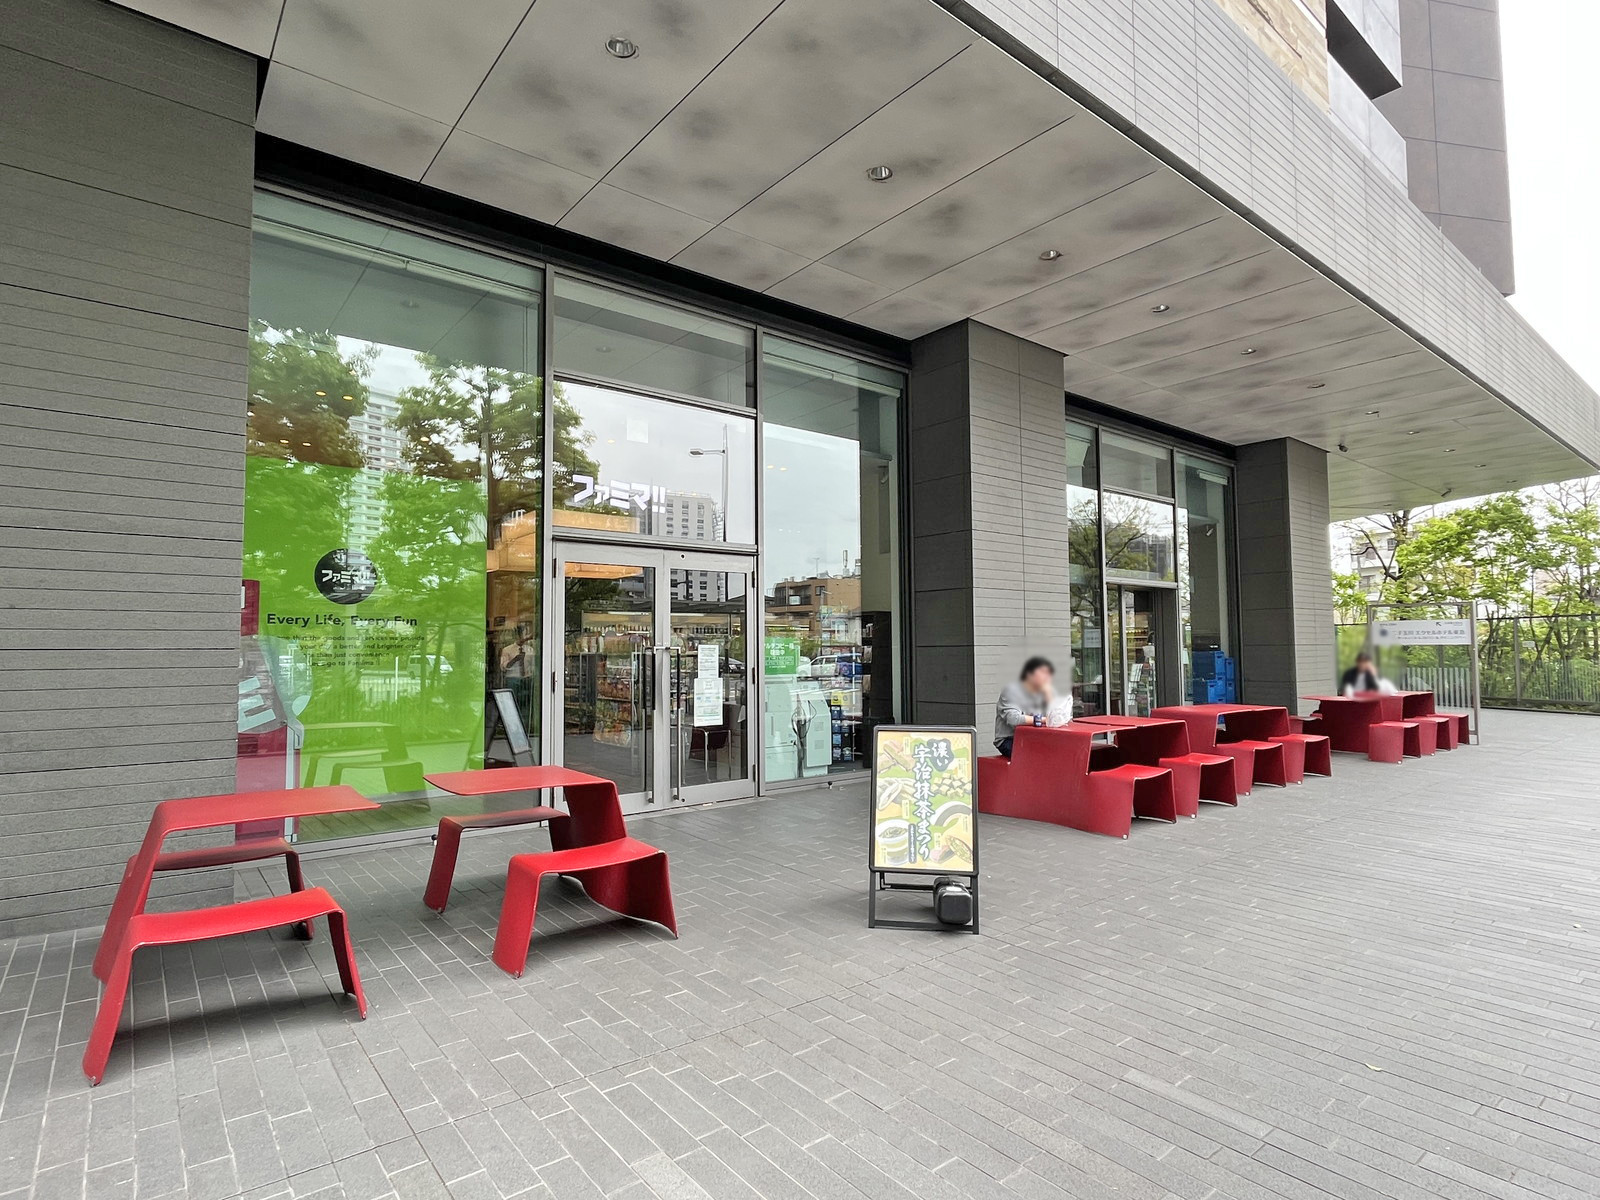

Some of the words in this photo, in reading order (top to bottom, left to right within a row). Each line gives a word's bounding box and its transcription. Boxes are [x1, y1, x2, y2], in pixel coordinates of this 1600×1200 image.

[267, 613, 310, 628] Every
[315, 614, 345, 627] Life,
[394, 615, 418, 626] Fun
[932, 741, 950, 767] 濃い
[912, 744, 935, 861] 宇治抹茶まつり
